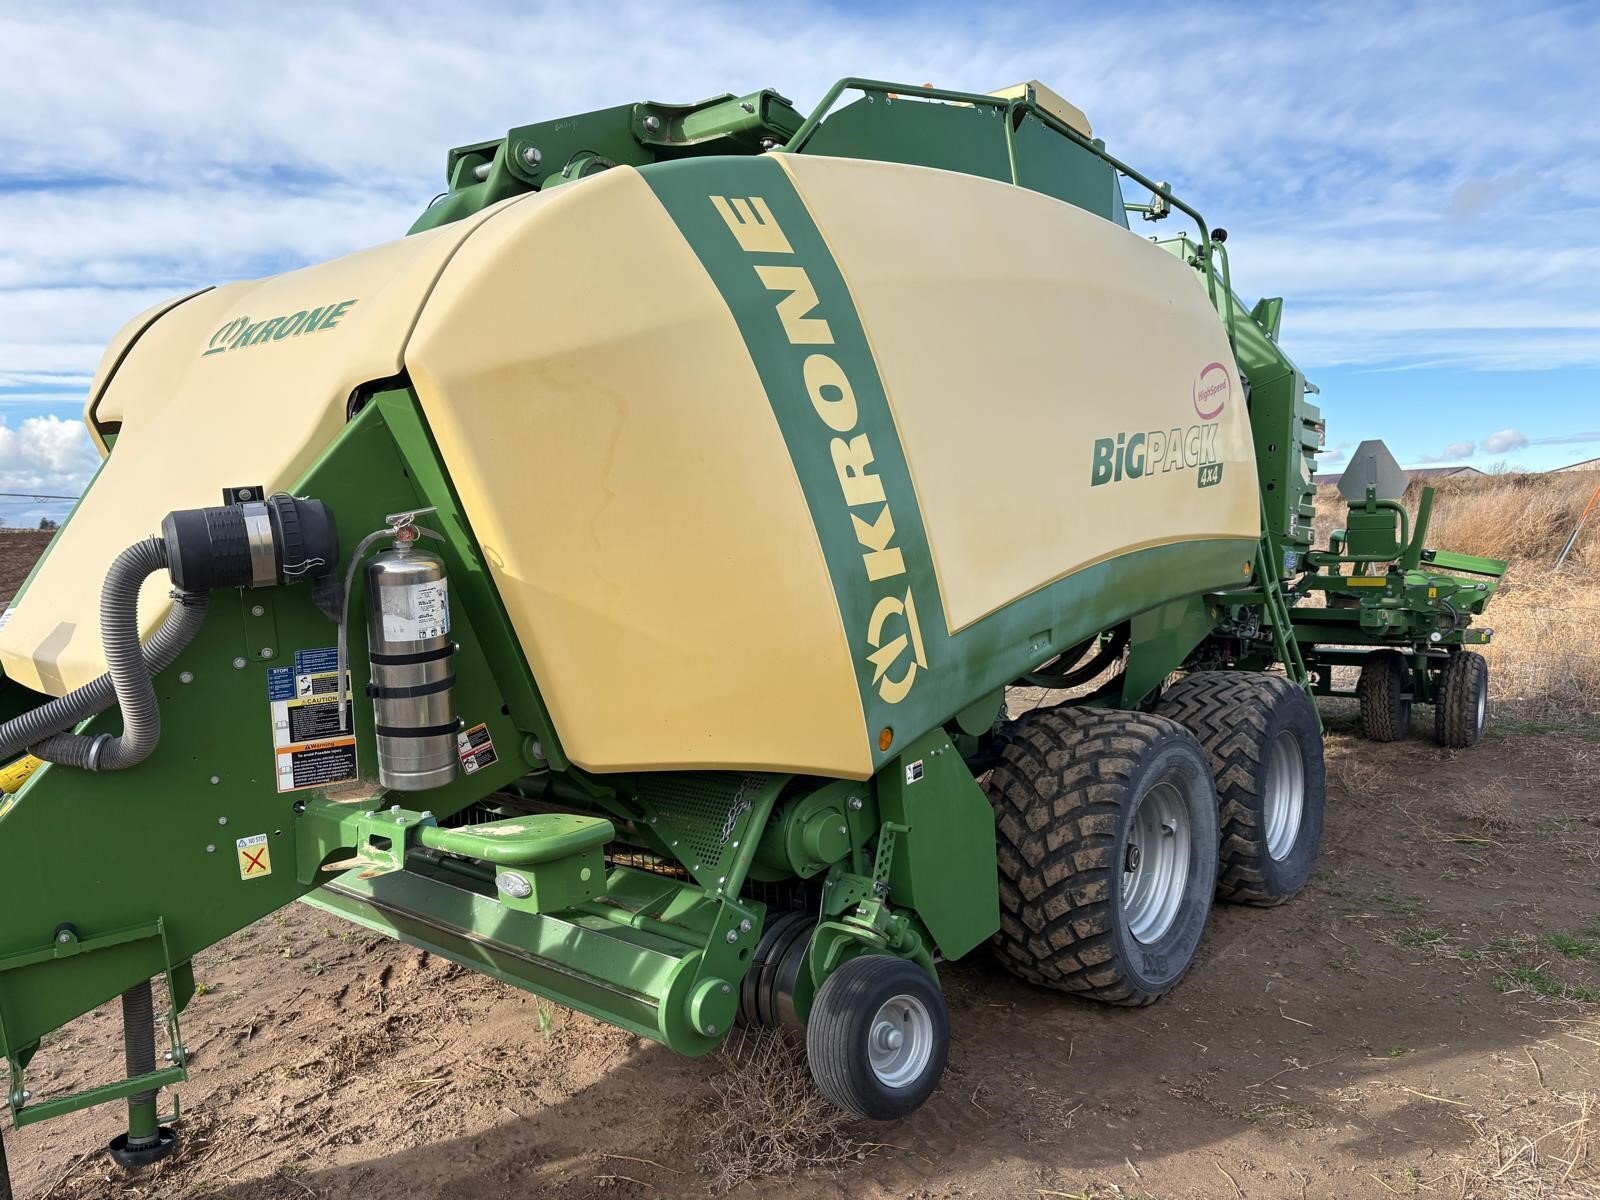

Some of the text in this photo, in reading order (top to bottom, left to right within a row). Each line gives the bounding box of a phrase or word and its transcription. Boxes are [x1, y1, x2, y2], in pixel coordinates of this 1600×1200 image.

[228, 299, 359, 350] KRONE
[708, 195, 907, 582] KRONE
[1198, 379, 1227, 402] HighSpeed
[306, 696, 338, 704] CAUTION
[310, 742, 335, 750] Warning
